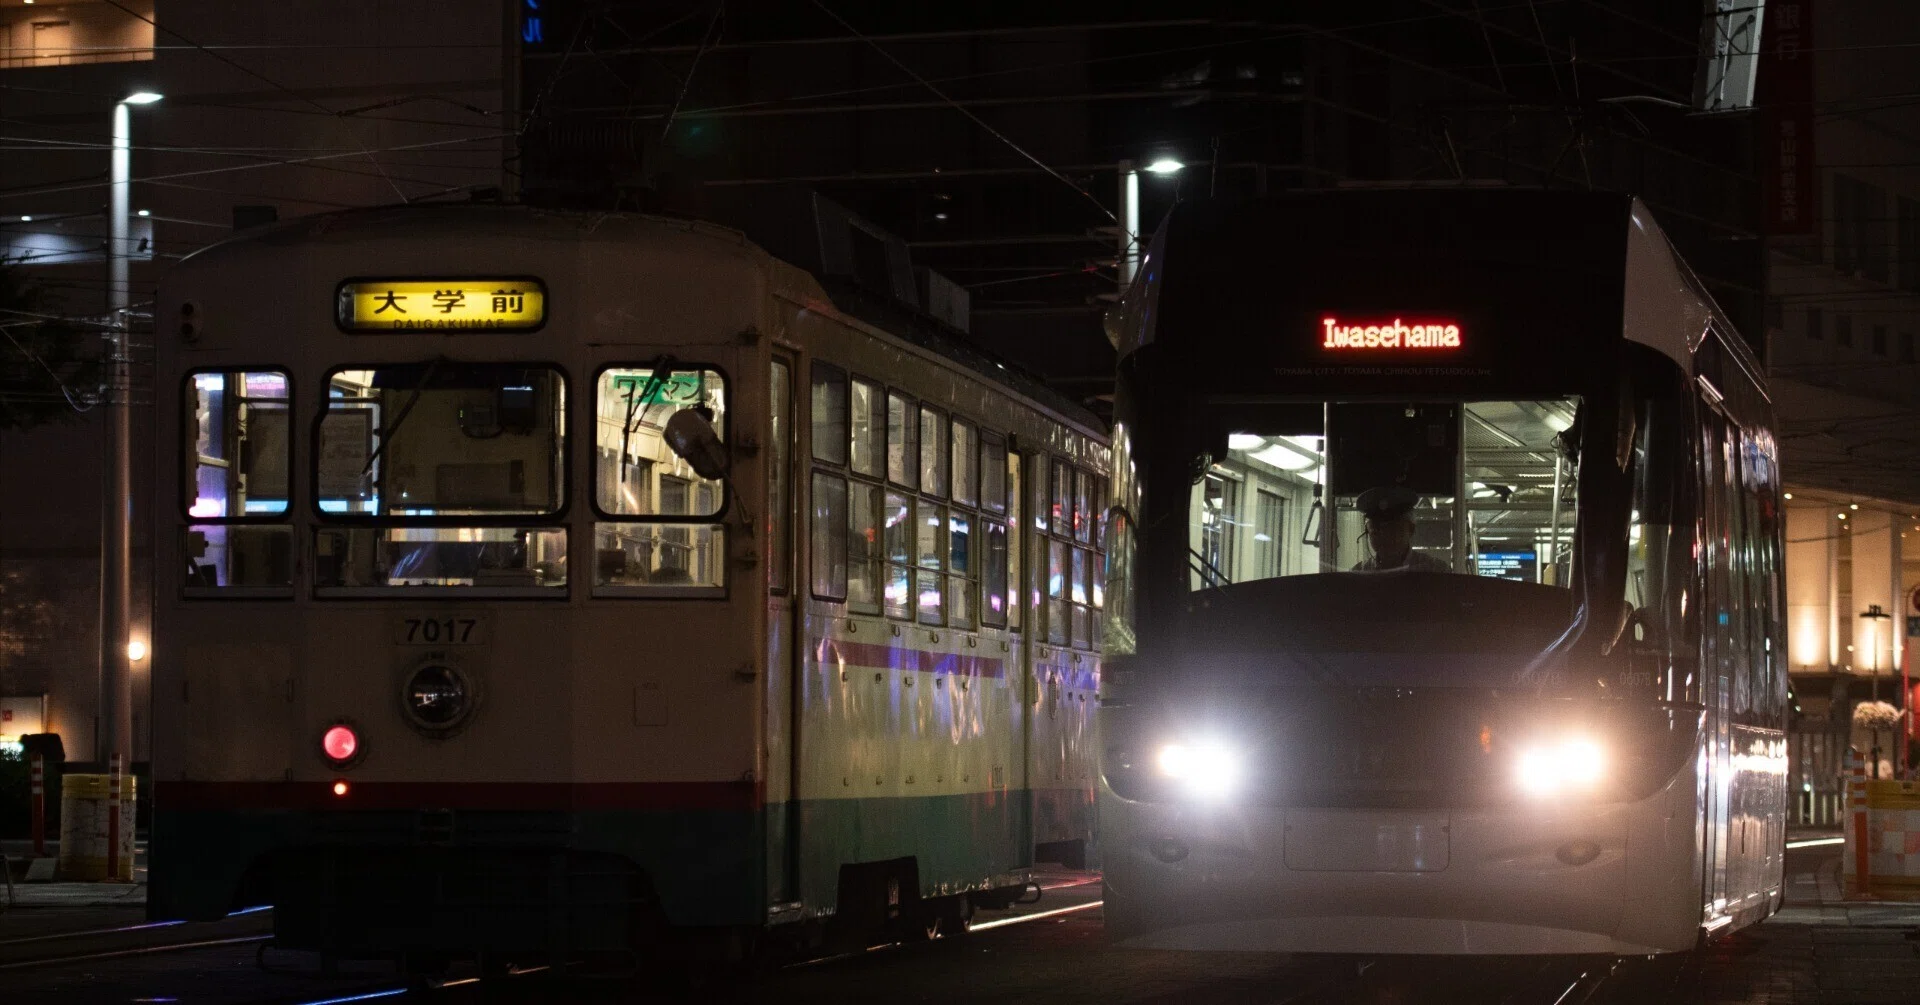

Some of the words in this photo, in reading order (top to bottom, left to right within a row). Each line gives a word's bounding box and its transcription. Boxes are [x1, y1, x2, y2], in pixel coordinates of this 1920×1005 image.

[1775, 4, 1801, 61] 銀行
[373, 290, 525, 315] 大学前
[1322, 318, 1461, 349] Iwasehama
[1273, 367, 1312, 376] TOYAMA
[1314, 367, 1335, 376] CITY
[1343, 367, 1382, 376] TOYAMA
[405, 619, 475, 642] 7017
